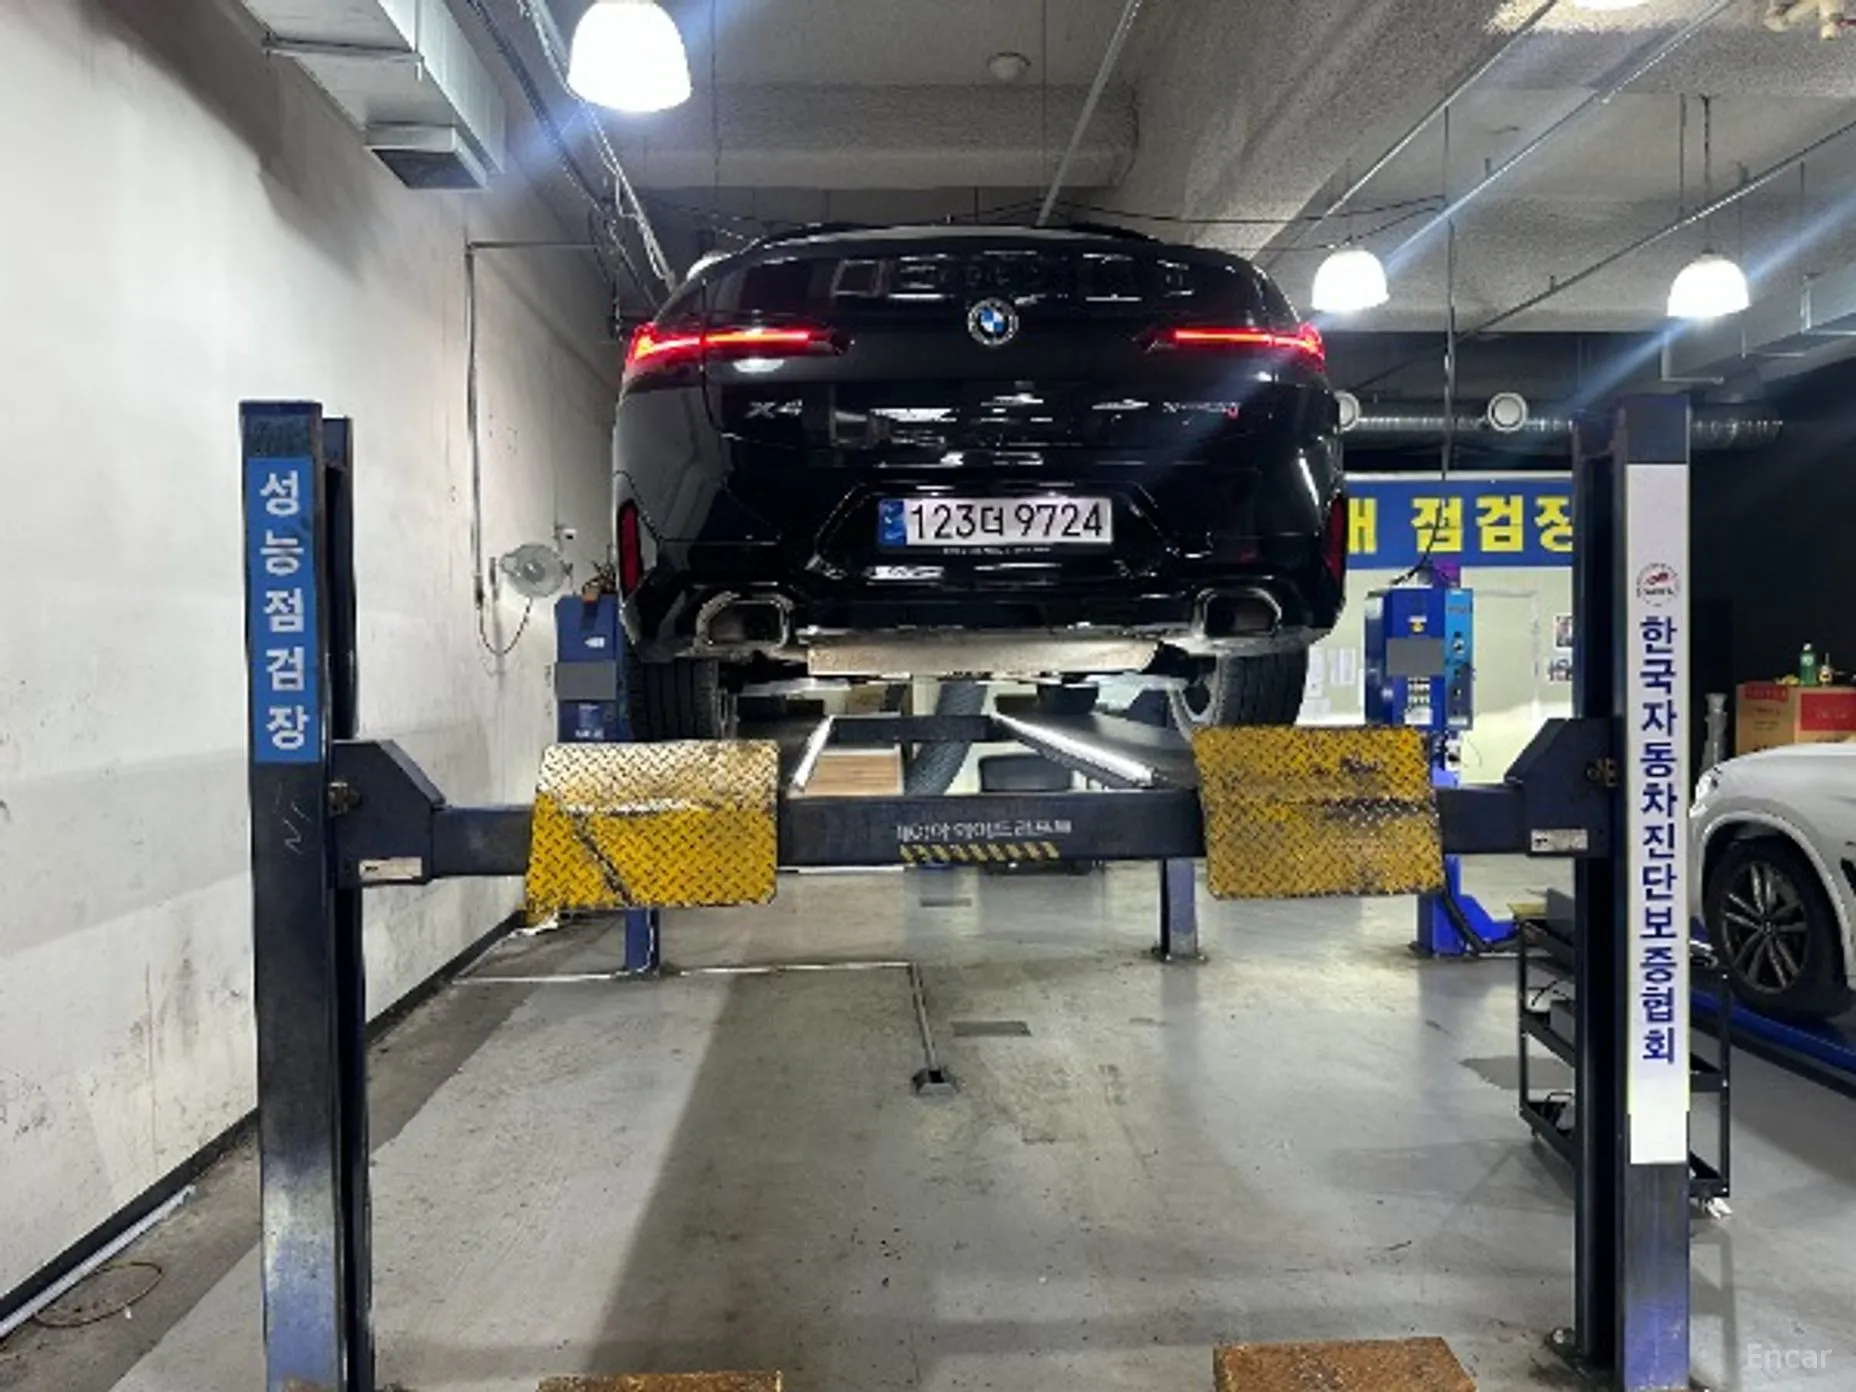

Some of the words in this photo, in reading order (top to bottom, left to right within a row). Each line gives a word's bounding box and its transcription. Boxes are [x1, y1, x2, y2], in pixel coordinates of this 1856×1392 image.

[745, 399, 802, 419] X4
[911, 501, 1004, 540] 123더
[1014, 502, 1103, 537] 9724
[259, 470, 310, 751] 성능점검장
[1639, 615, 1678, 1065] 한국자동차진단보증협회
